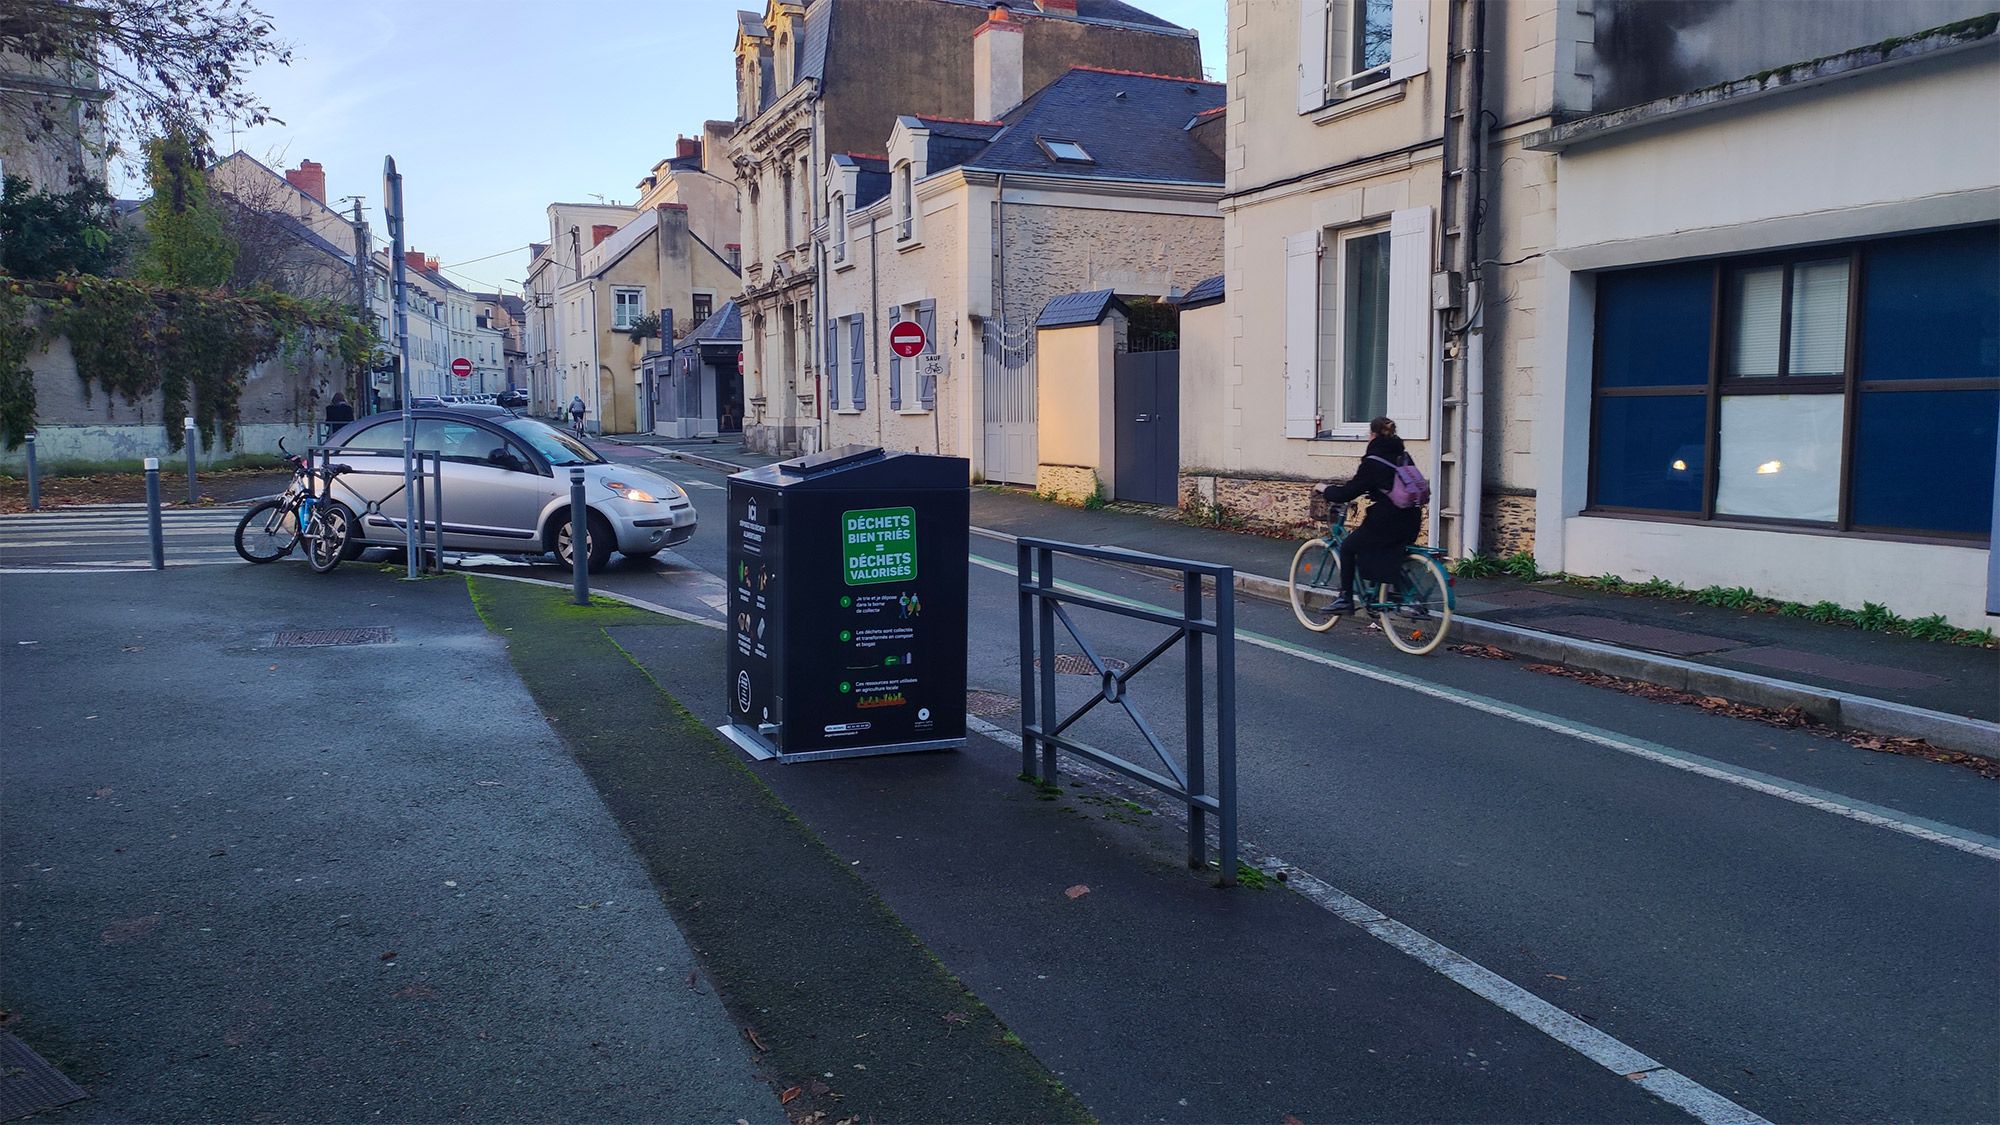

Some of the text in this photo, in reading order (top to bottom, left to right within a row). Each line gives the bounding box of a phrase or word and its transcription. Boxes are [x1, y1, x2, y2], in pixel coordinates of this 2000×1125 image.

[848, 515, 910, 530] DÉCHETS
[848, 528, 910, 543] BIEN TRIÉS
[849, 553, 911, 568] DÉCHETS
[850, 564, 911, 579] VALORISÉS
